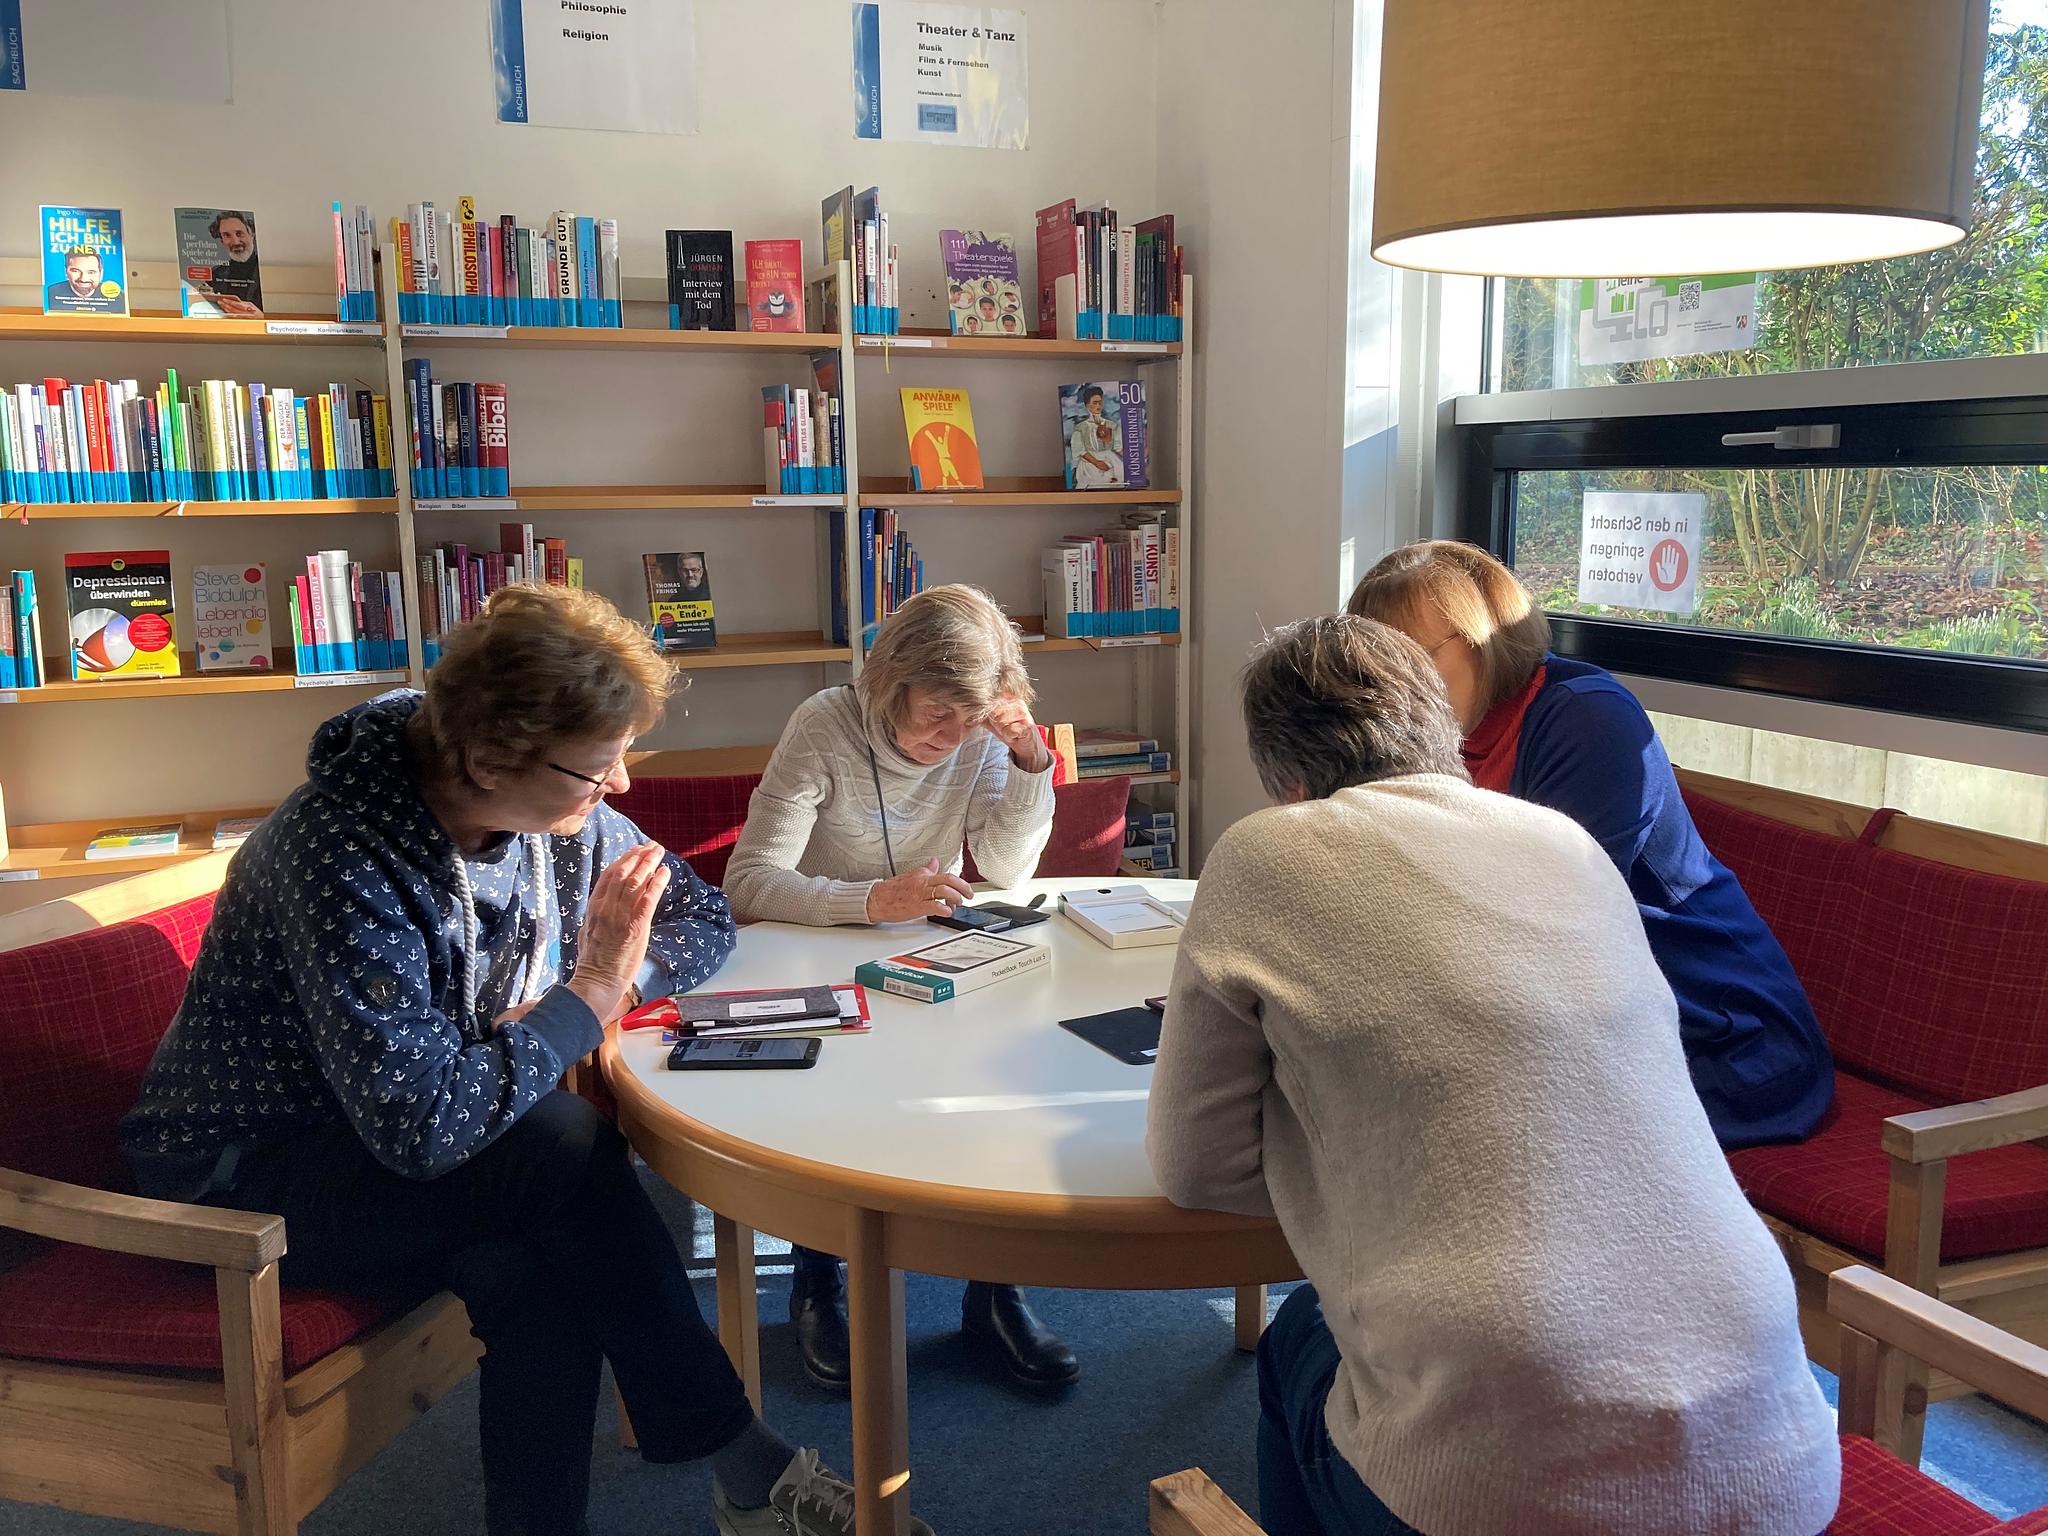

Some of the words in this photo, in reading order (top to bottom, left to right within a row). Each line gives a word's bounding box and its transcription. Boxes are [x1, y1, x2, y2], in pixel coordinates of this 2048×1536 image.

[561, 1, 627, 15] Philosophie
[562, 28, 609, 41] Religion
[917, 22, 967, 37] Theater
[972, 27, 981, 38] &
[985, 29, 1016, 41] Tanz
[9, 27, 20, 85] SACHBUCH
[918, 43, 943, 52] Musik
[918, 56, 936, 64] Film
[939, 57, 945, 65] &
[947, 58, 989, 69] Fernsehen
[917, 68, 942, 77] Kunst
[515, 65, 524, 118] SACHBUCH
[871, 85, 880, 134] SACHBUCH
[49, 217, 117, 235] HILFE,
[427, 210, 436, 259] PHILOSOPHEN
[557, 216, 567, 241] GUT
[50, 232, 79, 243] ICH
[84, 233, 112, 245] BIN
[950, 240, 965, 249] 111
[50, 243, 71, 254] ZU
[74, 245, 117, 255] NETT!
[690, 252, 723, 262] JÜRGEN
[952, 250, 1014, 264] Theaterspiele
[463, 230, 479, 294] PHILOSOPH
[559, 245, 569, 295] GRUNDE
[682, 279, 723, 288] Interview
[685, 290, 700, 299] mit
[702, 290, 721, 299] dem
[695, 300, 712, 309] Tod
[421, 387, 429, 402] DER
[913, 390, 961, 402] ANWÄRM
[1120, 383, 1141, 405] 50
[422, 403, 430, 422] WELT
[923, 402, 953, 411] SPIELE
[88, 394, 97, 448] KONTAKTABBRUCH
[362, 416, 371, 436] DURCH
[461, 415, 469, 433] Bibel
[478, 412, 488, 447] Lexikon
[486, 396, 506, 447] Bibel
[151, 436, 159, 457] SPITZER
[365, 437, 373, 455] STARK
[1127, 407, 1141, 476] KÜNSTLERINNEN
[1146, 544, 1159, 584] KUNST
[73, 575, 165, 590] Depressionen
[194, 571, 240, 586] Steve
[1134, 563, 1143, 597] KUNST
[90, 589, 150, 600] überwinden
[195, 587, 264, 604] Biddulph
[311, 575, 322, 619] TUITION
[196, 606, 266, 622] Lebendig
[679, 610, 707, 618] Ende?
[197, 622, 242, 639] leben!
[298, 679, 334, 687] Psychologie
[991, 965, 1017, 978] PocketBook
[1018, 958, 1033, 968] Touch
